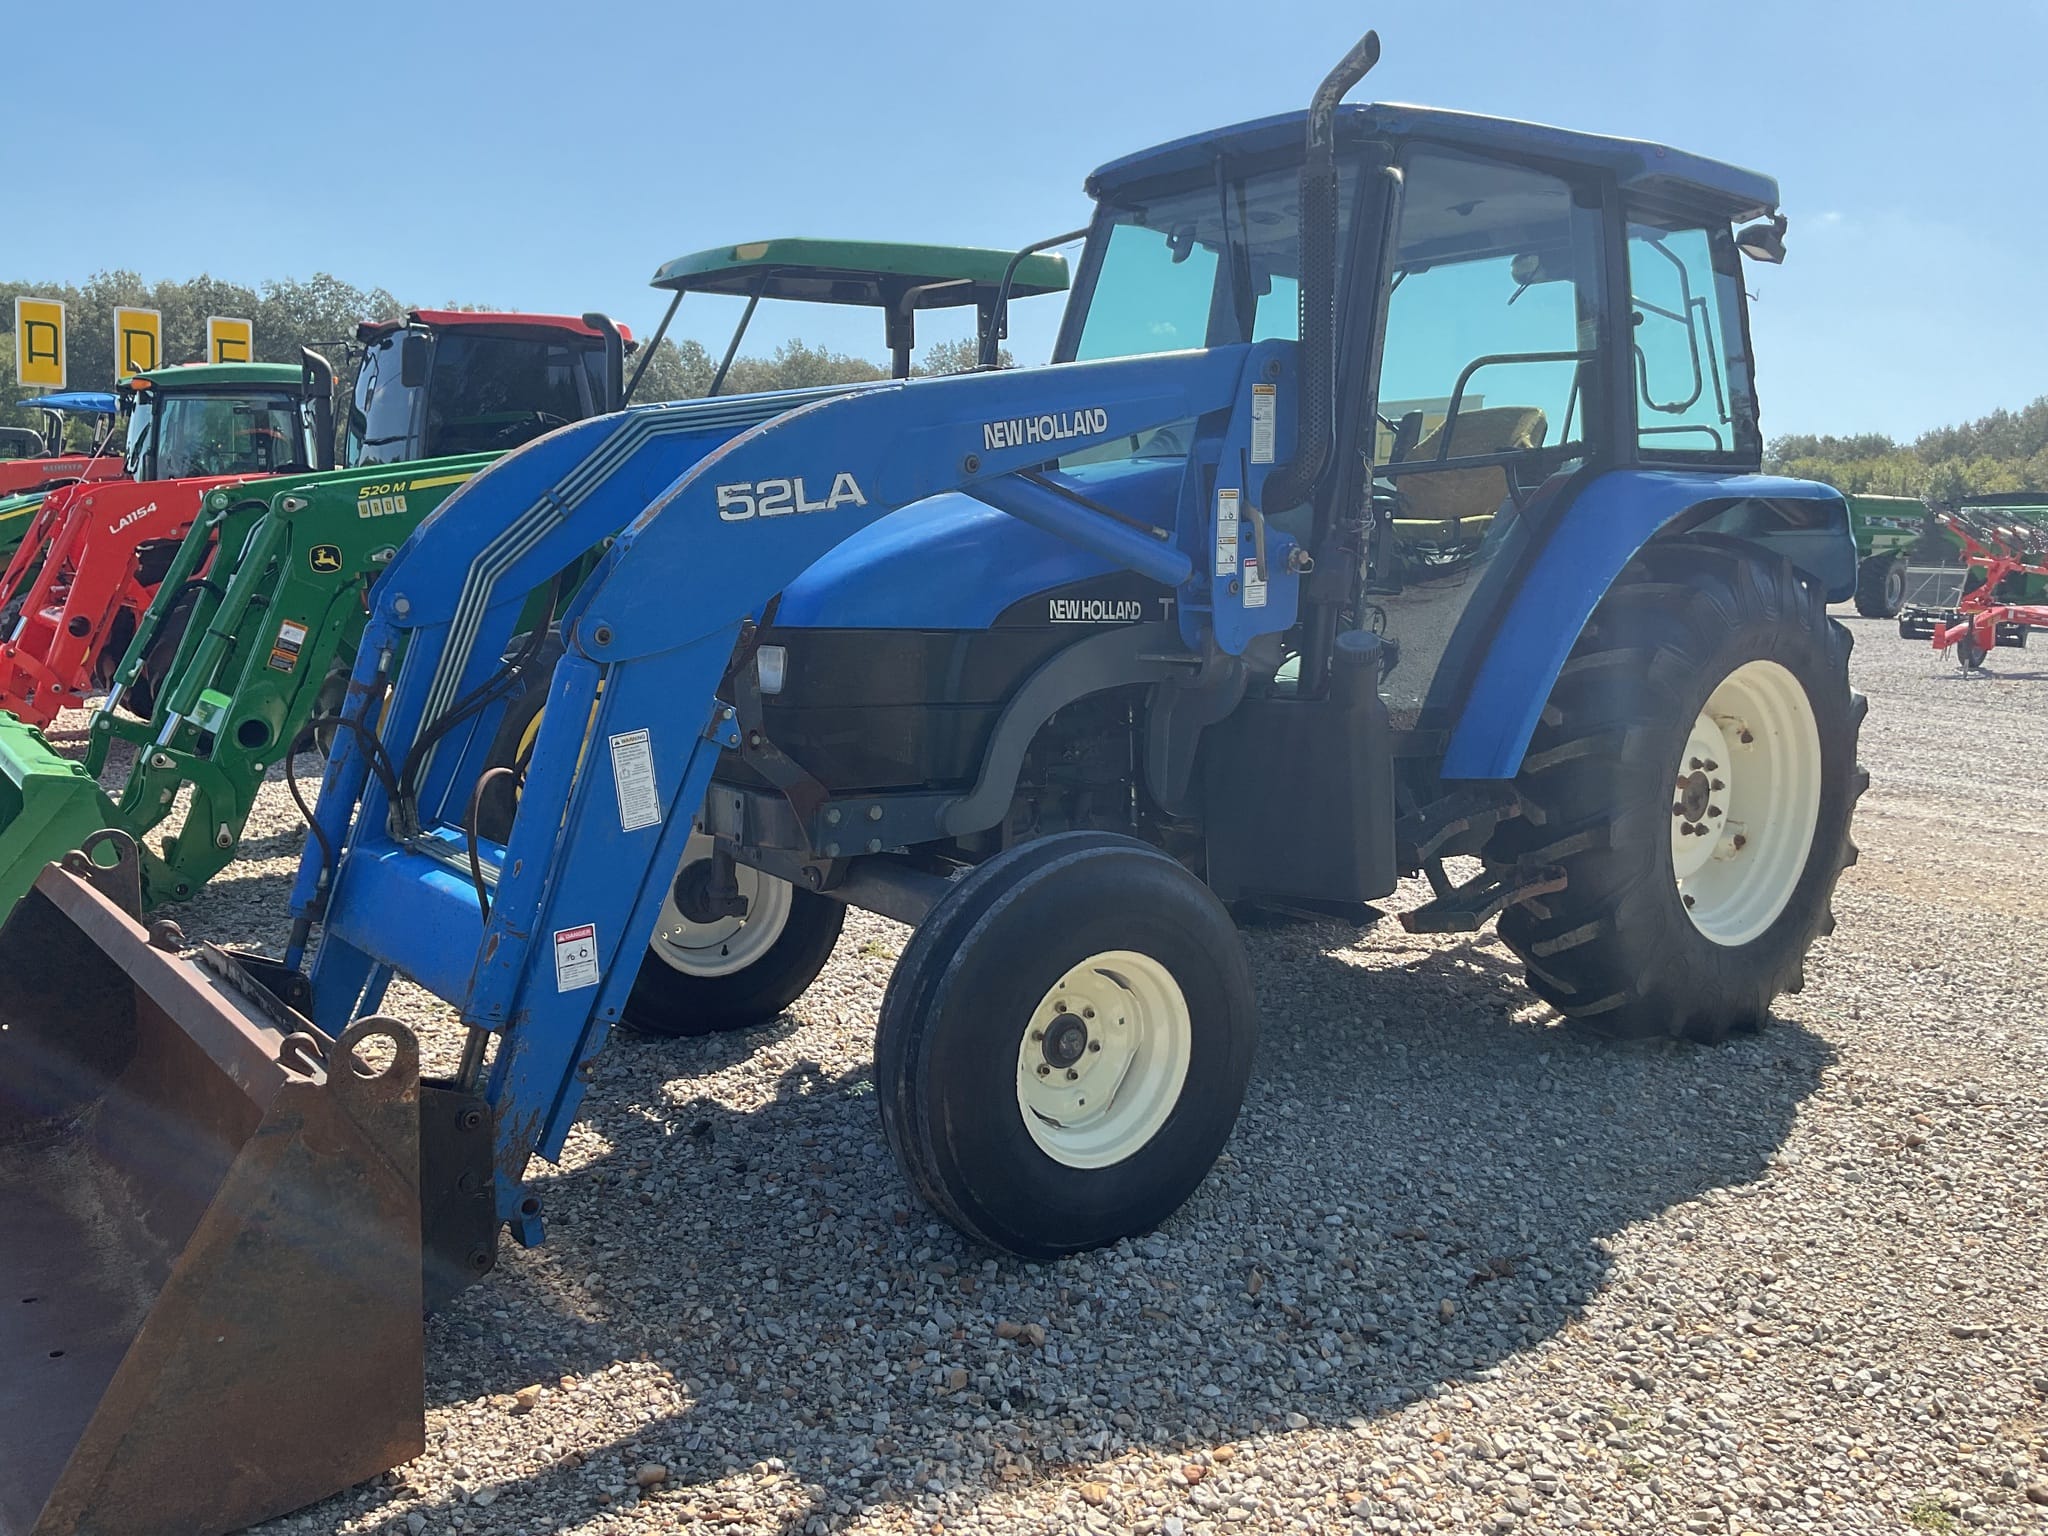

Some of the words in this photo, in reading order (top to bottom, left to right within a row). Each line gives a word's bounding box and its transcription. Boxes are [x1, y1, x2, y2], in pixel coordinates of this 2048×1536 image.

[25, 320, 58, 366] A
[123, 329, 155, 372] D
[983, 419, 1023, 450] NEW
[1025, 408, 1108, 443] HOLLAND
[358, 484, 390, 499] 520
[392, 481, 406, 493] M
[717, 472, 867, 521] 52LA
[109, 502, 157, 534] LA1154
[1049, 599, 1080, 619] NEW
[1081, 599, 1141, 620] HOLLAND
